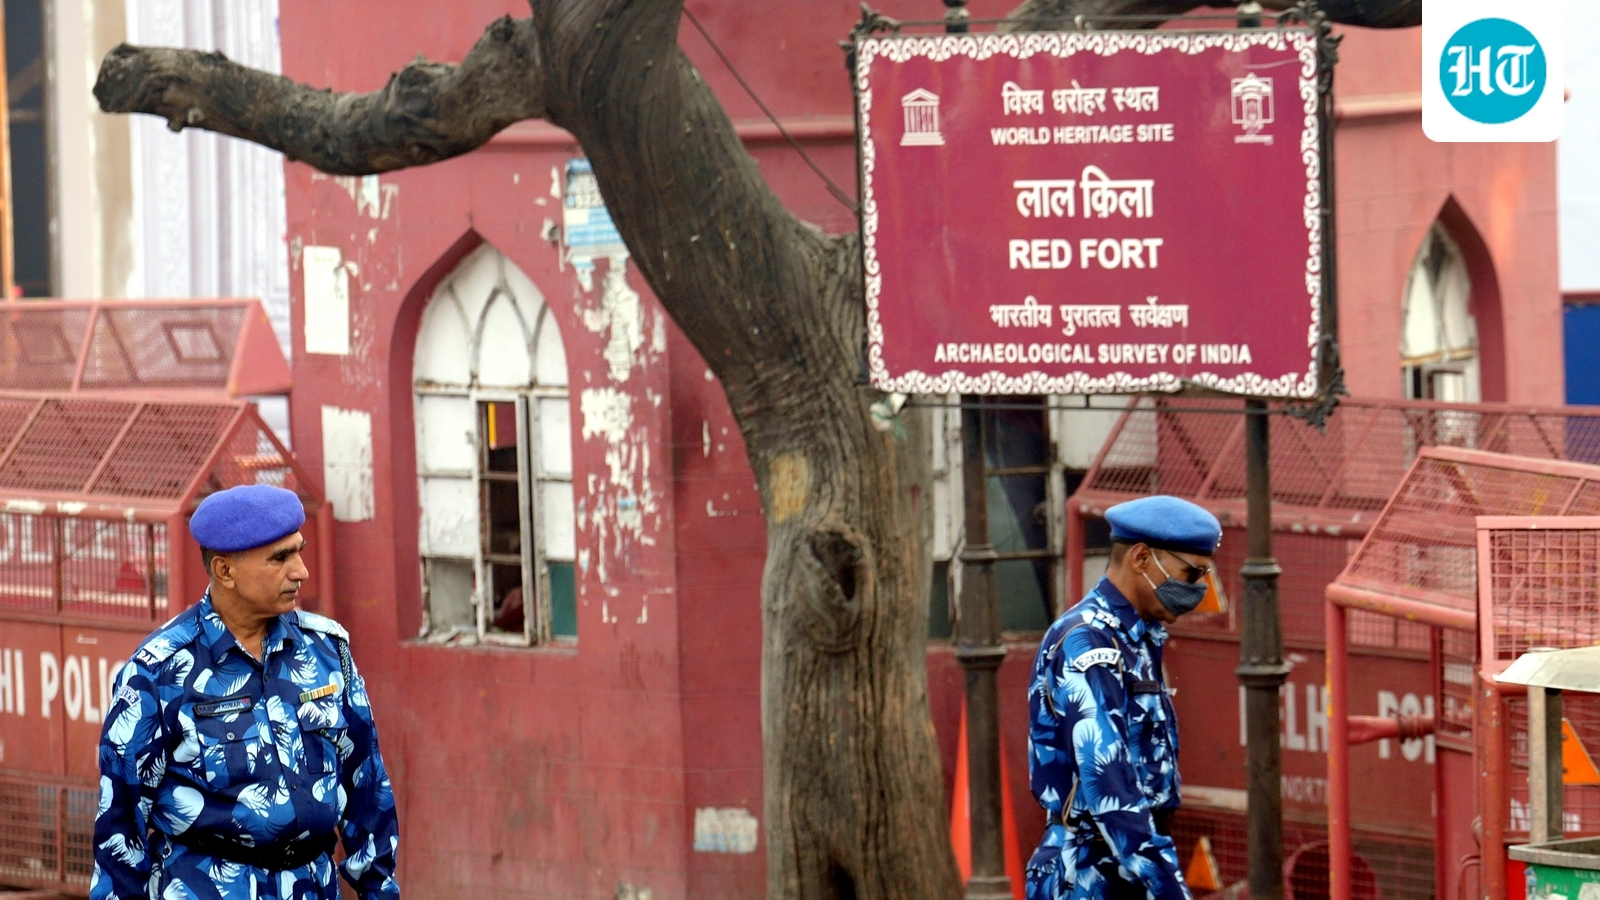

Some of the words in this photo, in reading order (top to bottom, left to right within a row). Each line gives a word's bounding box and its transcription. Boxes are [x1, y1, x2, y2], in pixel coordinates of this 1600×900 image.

[1001, 81, 1045, 116] विश्व
[1052, 79, 1107, 116] धरोहर
[1111, 86, 1160, 113] स्थल
[990, 126, 1050, 146] WORLD
[1053, 124, 1134, 144] HERITAGE
[1136, 123, 1175, 142] SITE
[1013, 179, 1076, 219] लाल
[1008, 239, 1072, 270] RED
[1079, 238, 1164, 270] FORT
[989, 295, 1053, 328] भारतीय
[1059, 304, 1121, 336] पुरातत्व
[1128, 296, 1190, 328] सर्वेक्षण
[934, 343, 1095, 364] ARCHAEOLOGICAL
[1097, 343, 1169, 364] SURVEY
[1172, 344, 1197, 364] OF
[1201, 343, 1253, 364] INDIA
[40, 651, 119, 724] POLI
[1280, 774, 1329, 804] NORT
